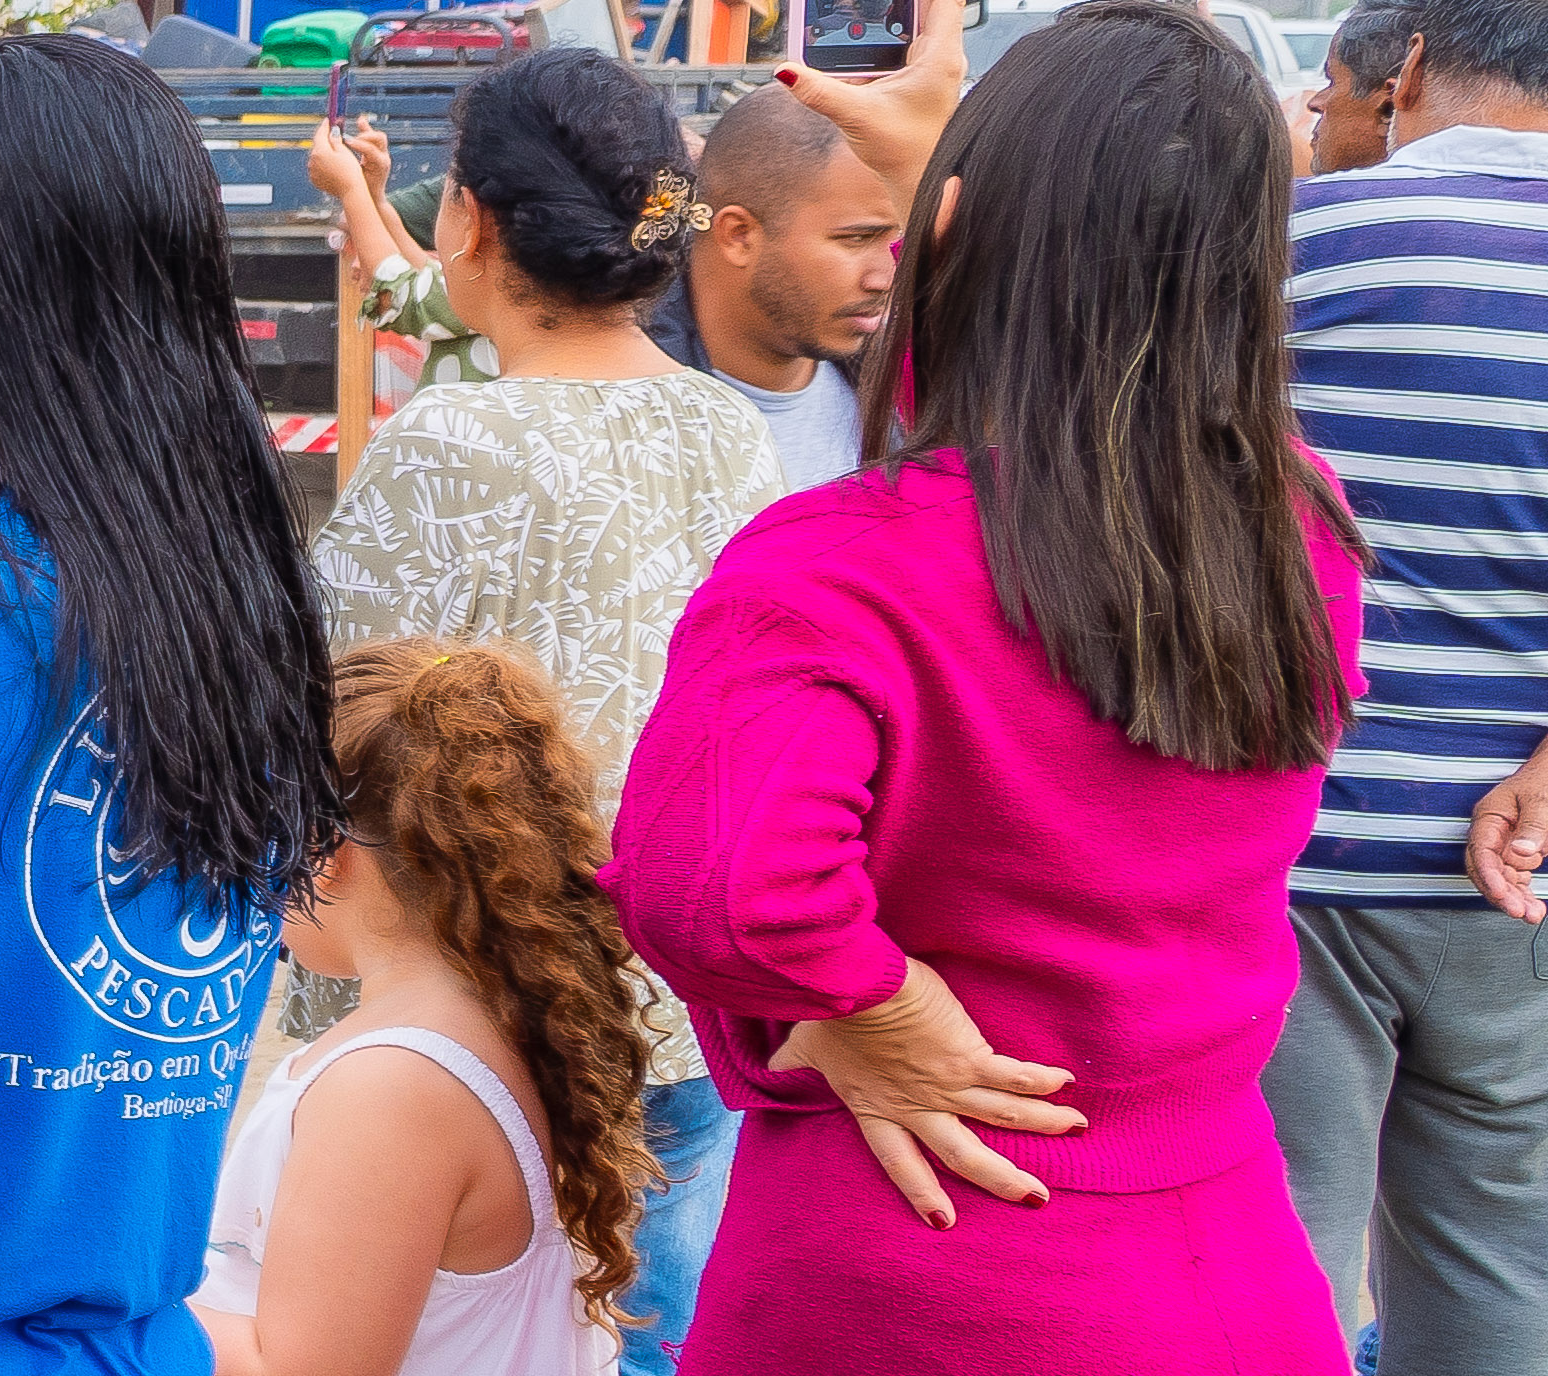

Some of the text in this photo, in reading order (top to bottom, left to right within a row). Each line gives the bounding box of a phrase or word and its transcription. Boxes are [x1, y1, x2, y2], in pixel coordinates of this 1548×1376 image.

[70, 909, 272, 1028] PESCADS
[160, 1054, 200, 1080] em
[121, 1083, 234, 1120] Bertioga-SP
